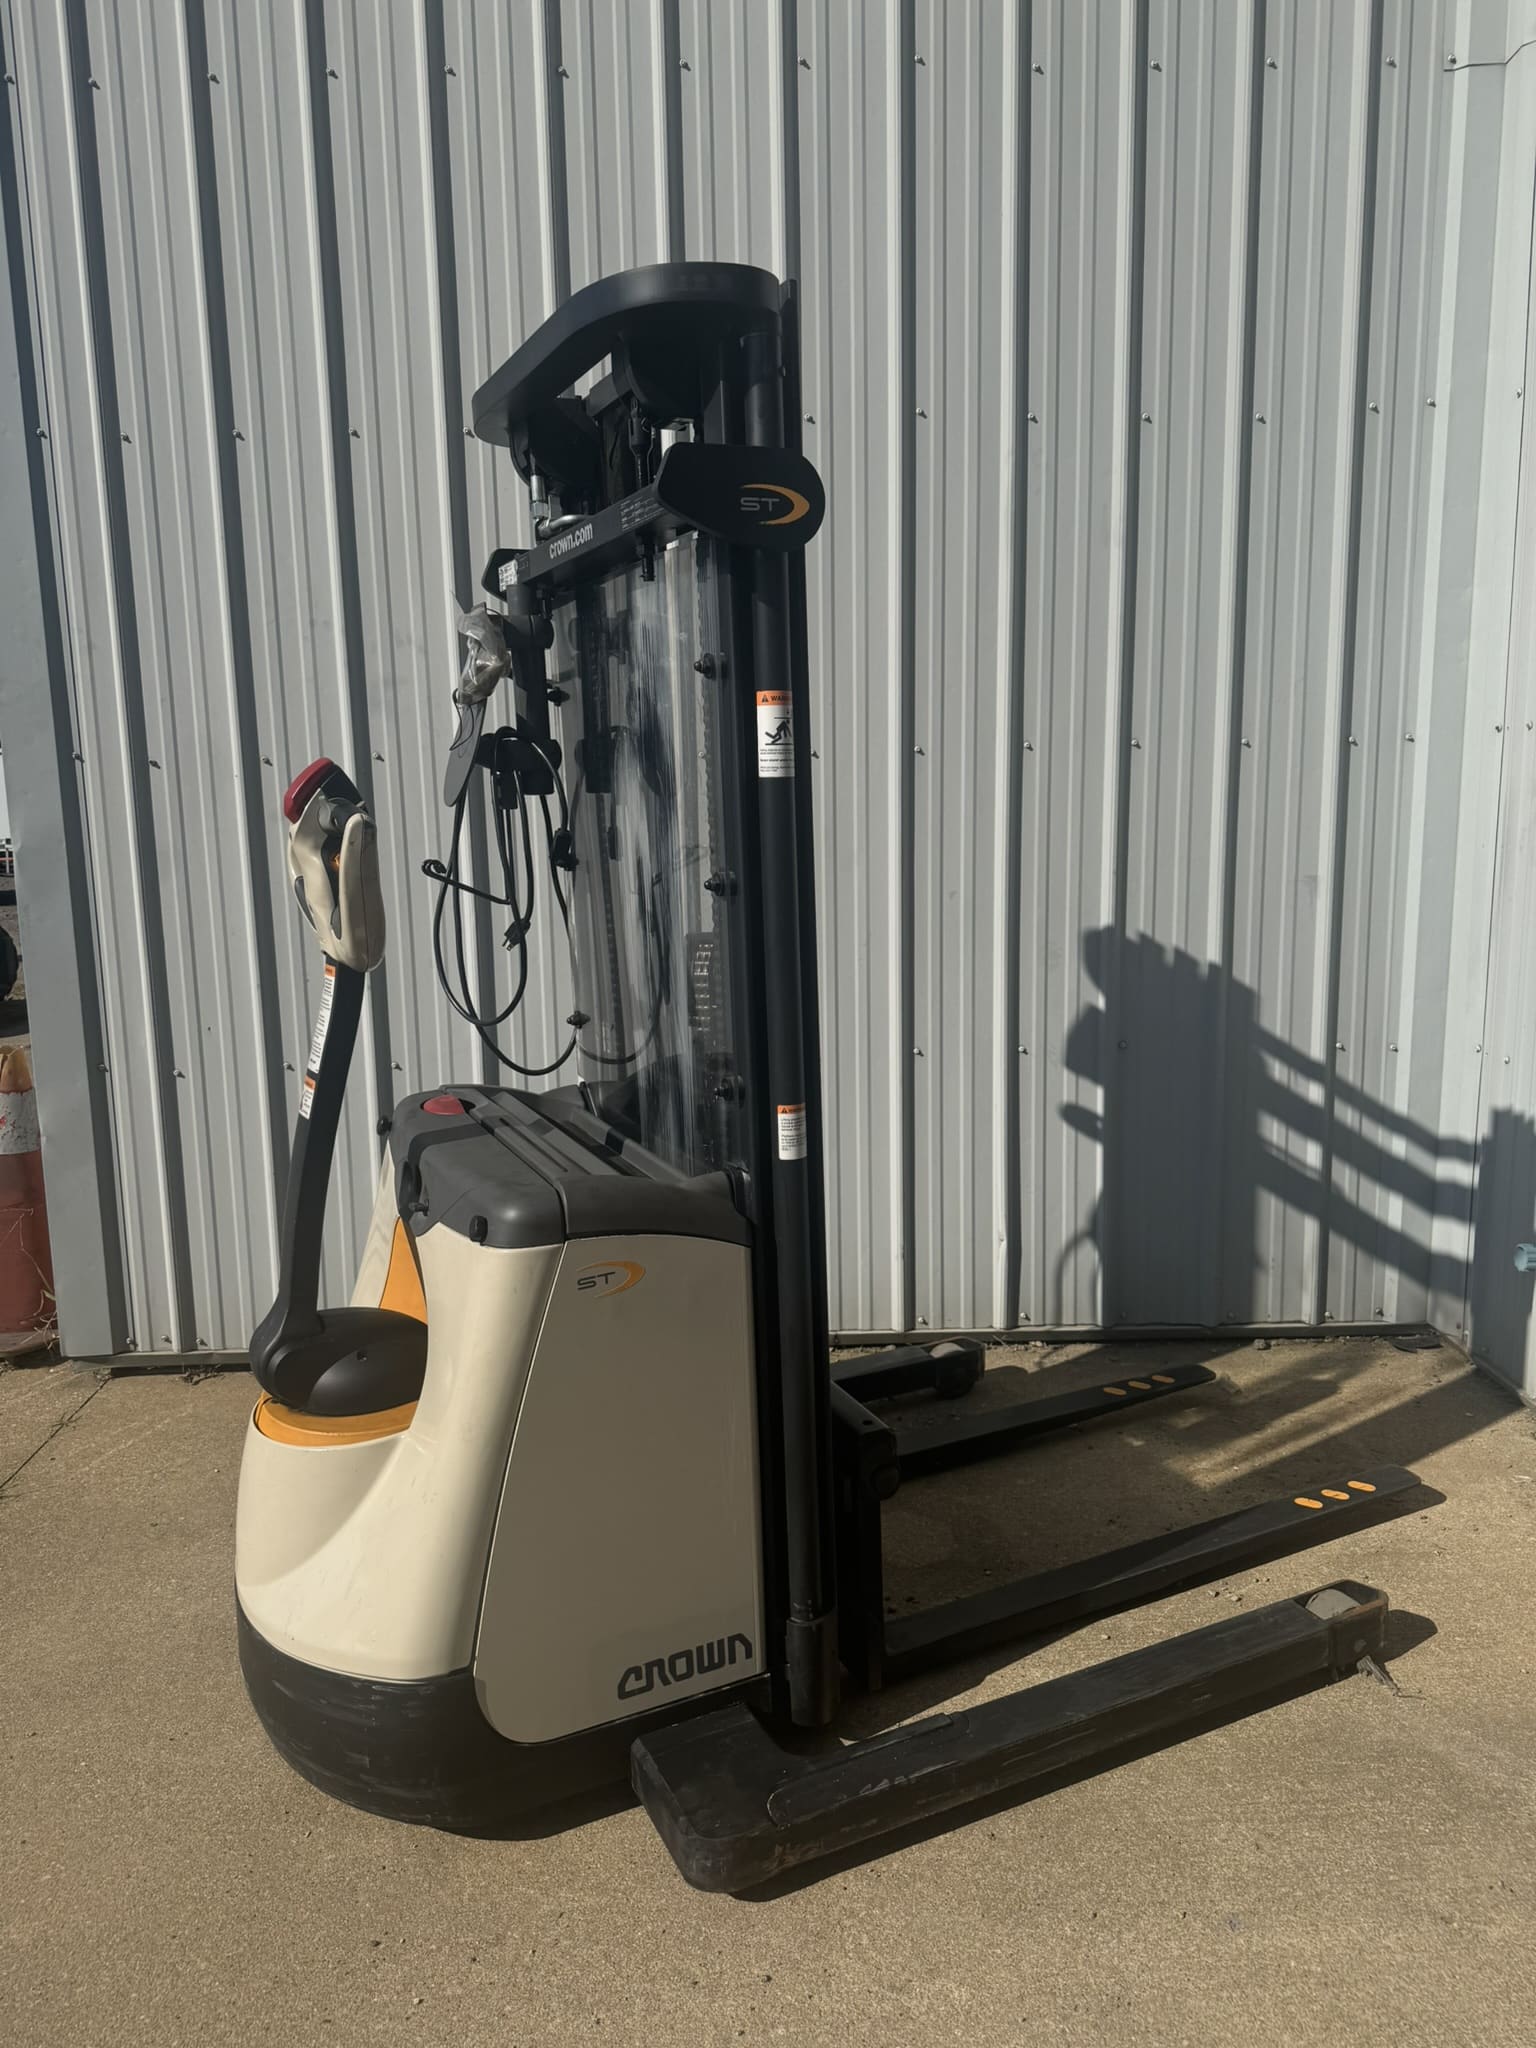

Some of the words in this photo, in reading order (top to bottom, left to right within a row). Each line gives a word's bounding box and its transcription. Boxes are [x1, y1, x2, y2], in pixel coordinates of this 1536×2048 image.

[740, 497, 780, 512] ST
[549, 523, 593, 559] crown.com
[577, 1271, 616, 1291] ST
[617, 1633, 753, 1700] CROWN
